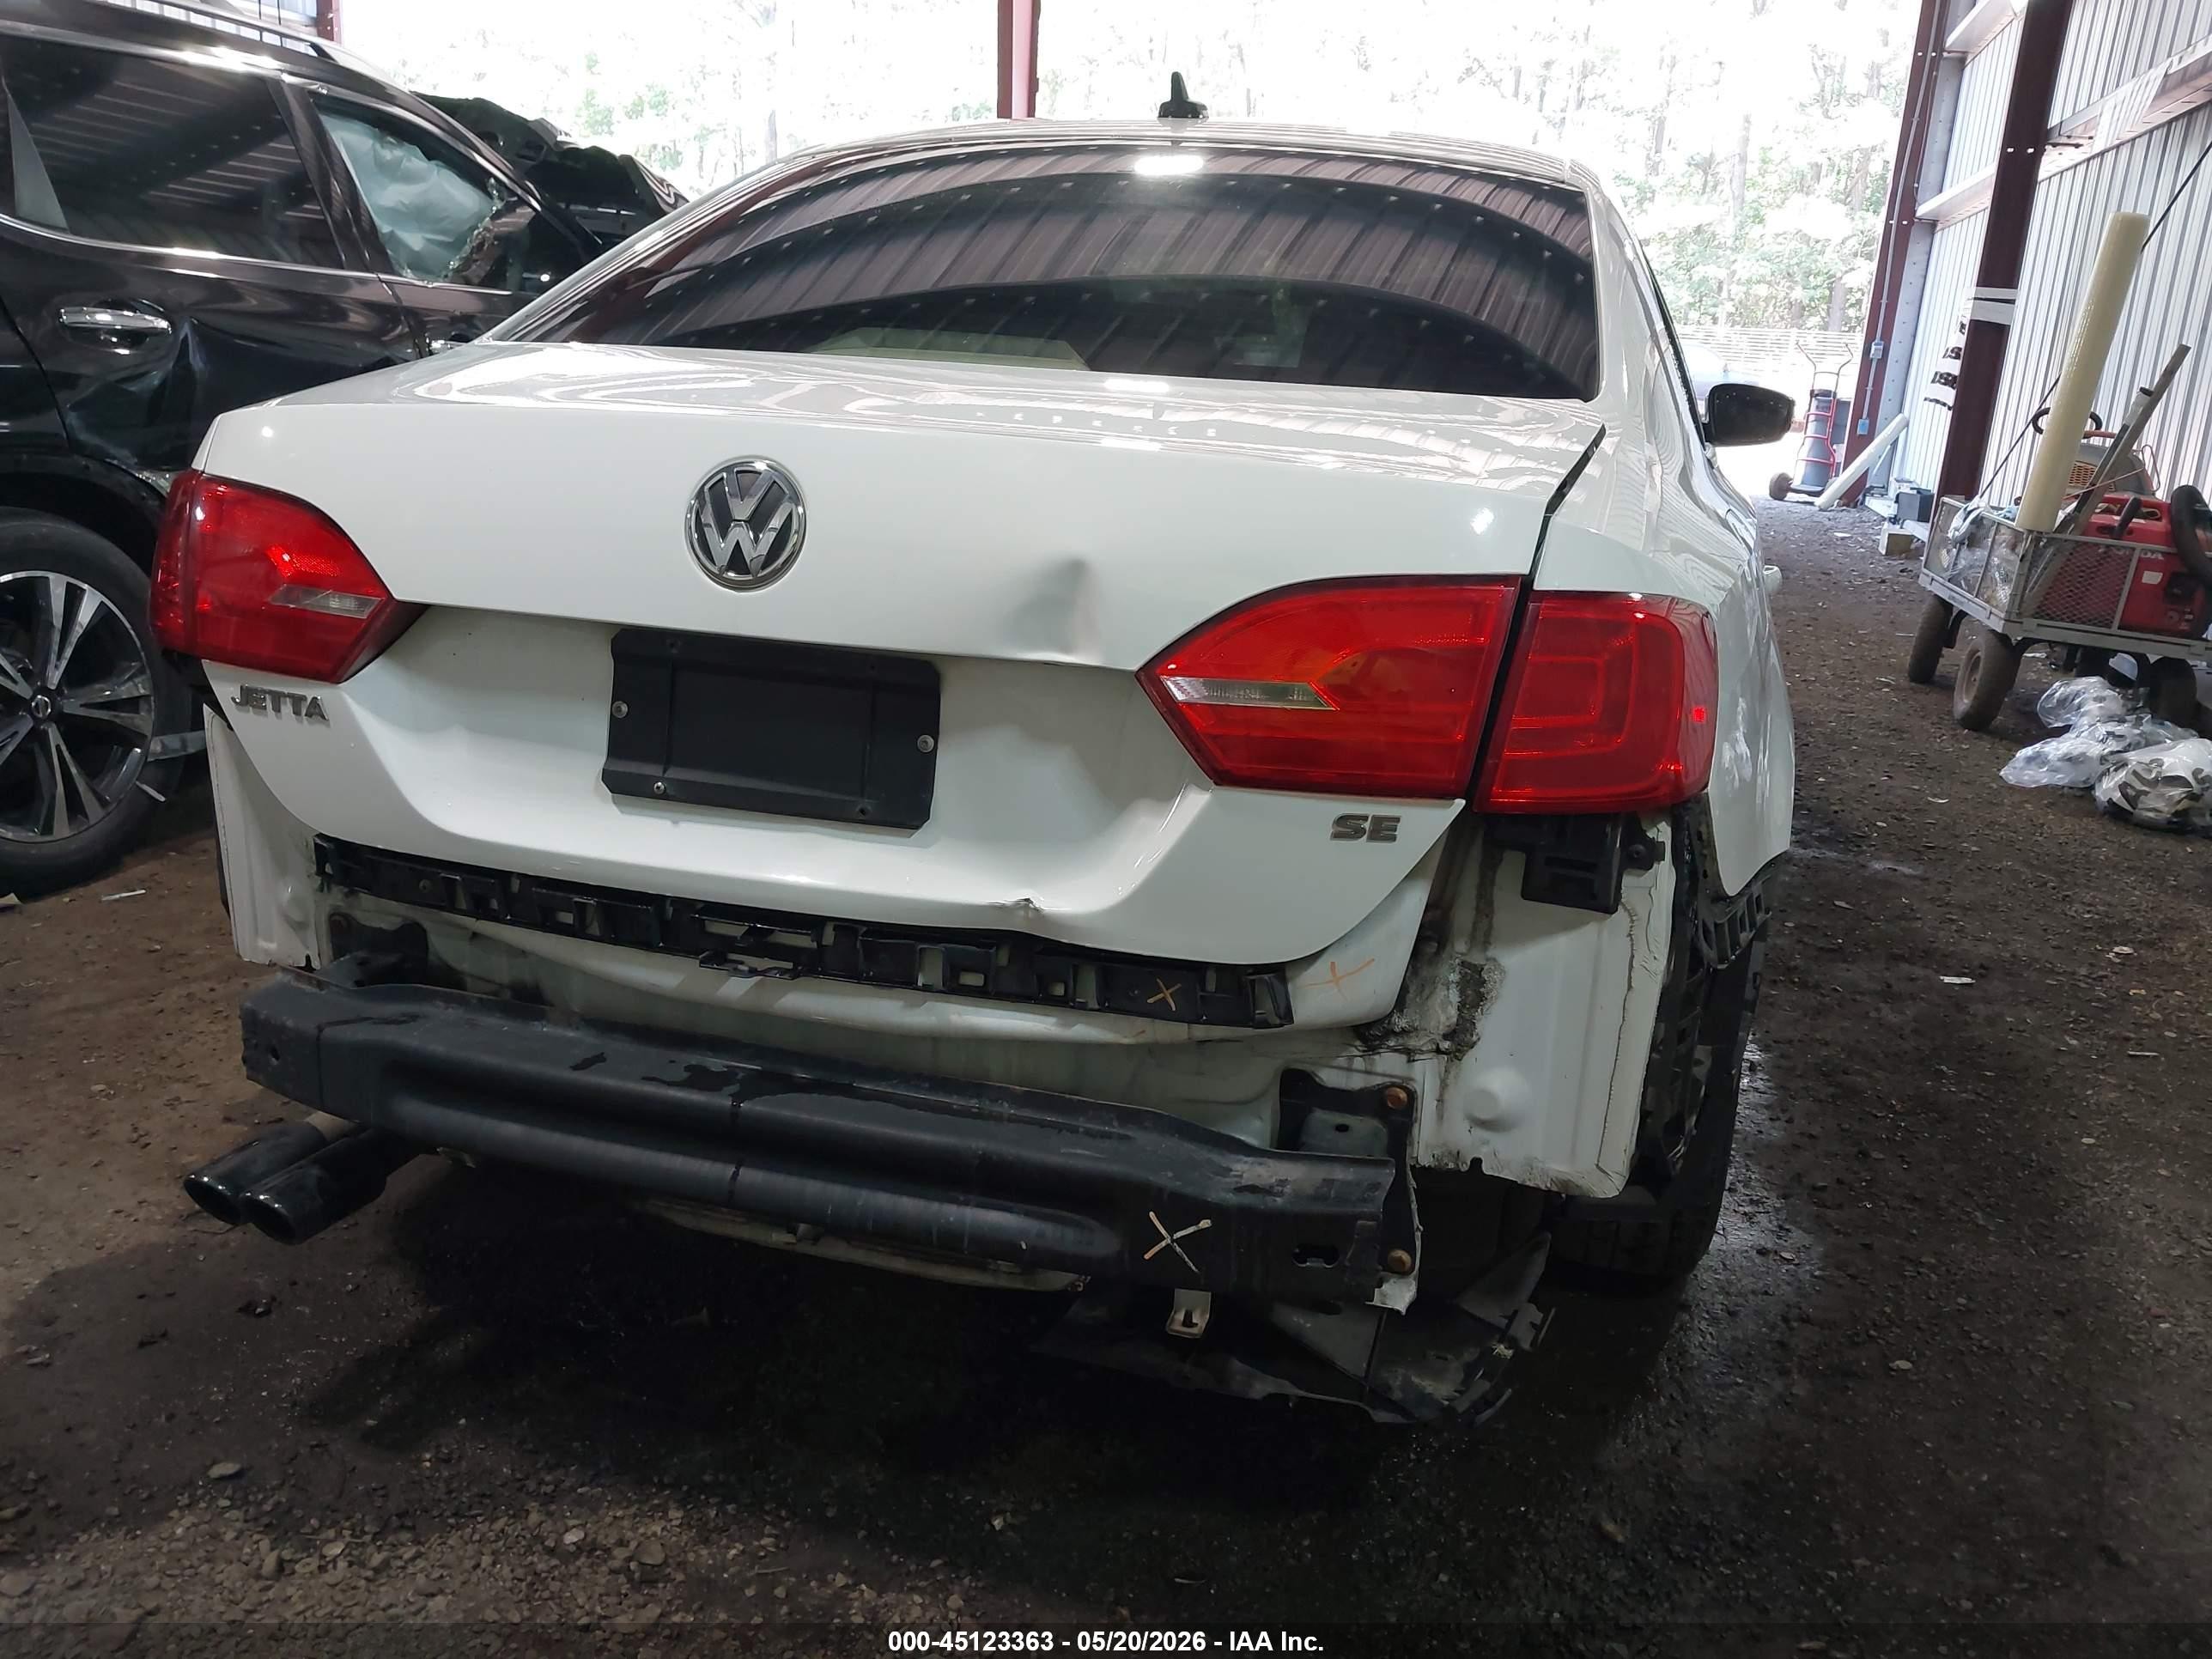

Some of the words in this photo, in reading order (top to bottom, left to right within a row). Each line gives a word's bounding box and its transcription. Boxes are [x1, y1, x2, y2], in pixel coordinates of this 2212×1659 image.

[686, 459, 804, 590] VW
[231, 684, 330, 721] JETTA
[1329, 812, 1401, 843] SE
